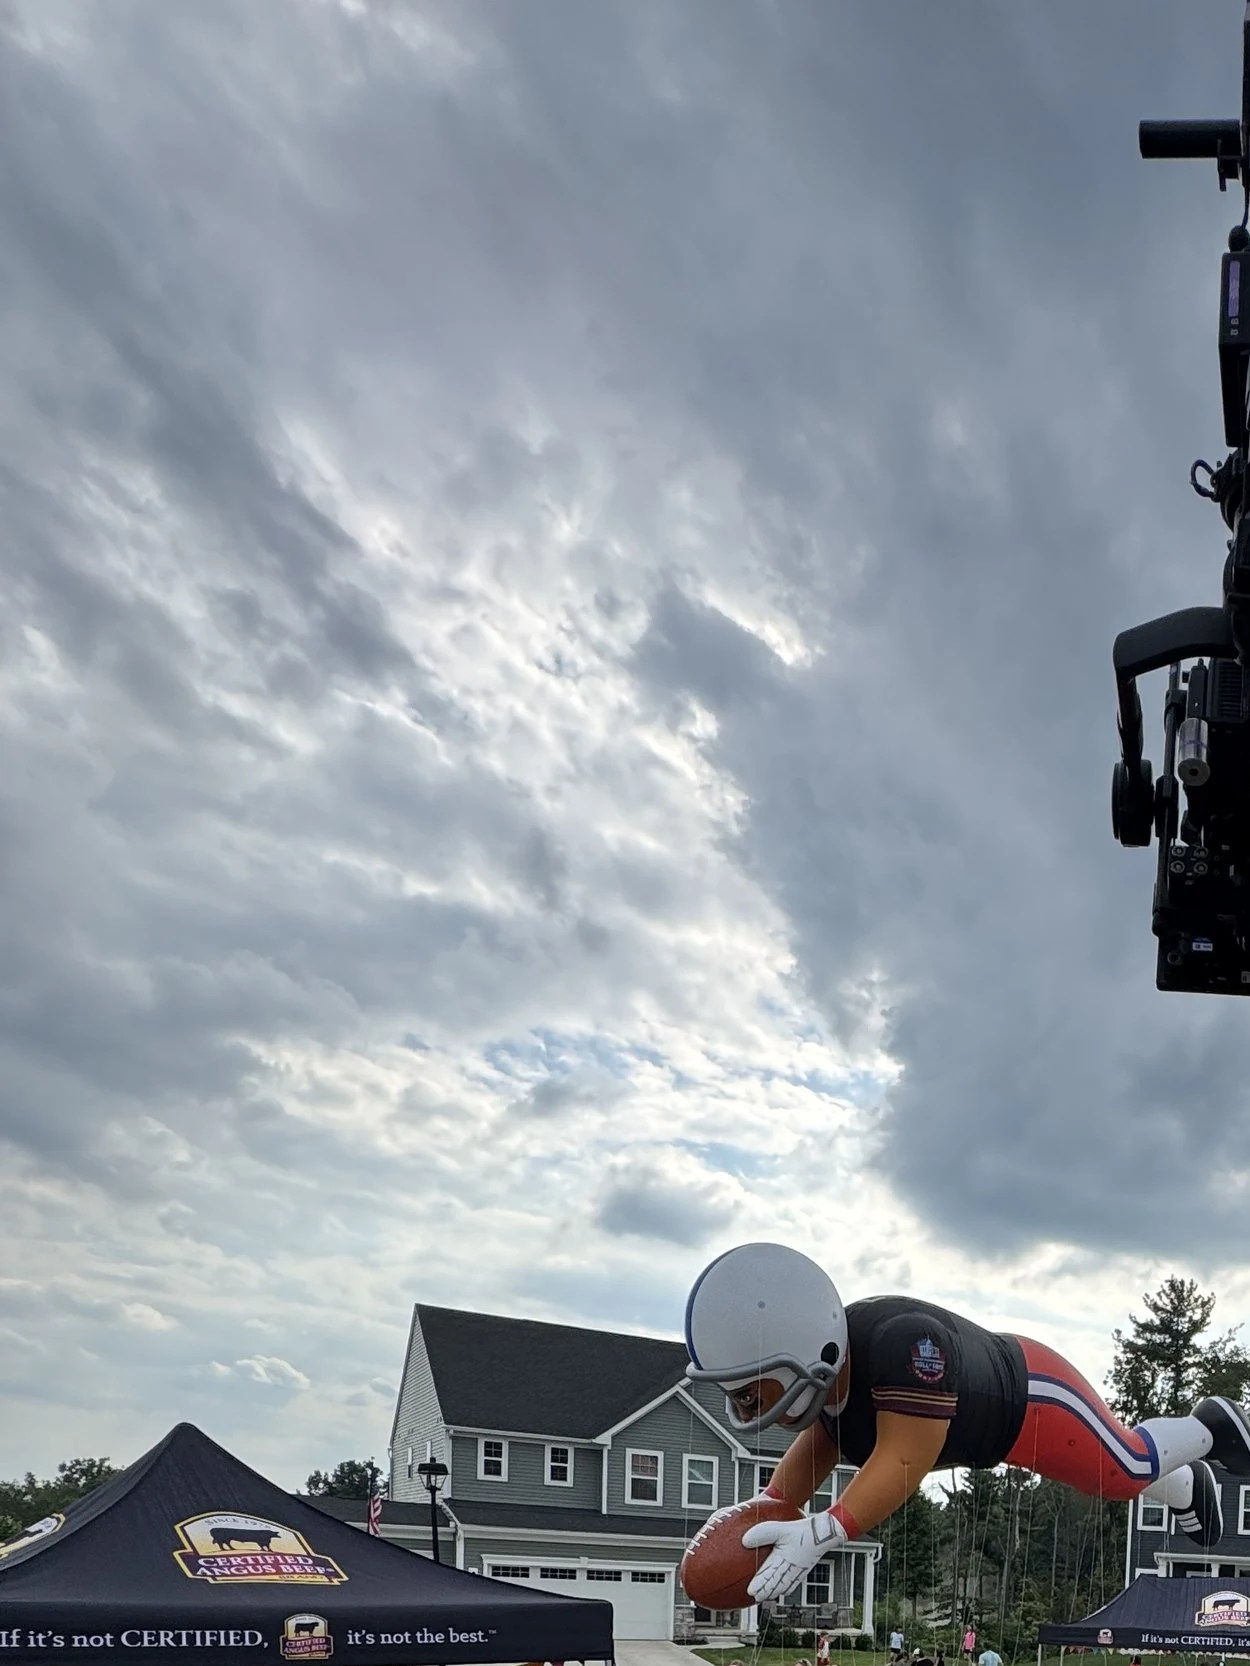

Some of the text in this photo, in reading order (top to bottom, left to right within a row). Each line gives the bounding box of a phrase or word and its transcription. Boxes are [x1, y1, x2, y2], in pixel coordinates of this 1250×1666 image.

[197, 1555, 314, 1568] CERTIFIED
[196, 1565, 276, 1576] ANGUS
[0, 1629, 22, 1648] If
[72, 1633, 115, 1648] not
[120, 1629, 269, 1649] CERTIFIED,
[379, 1631, 412, 1645] not
[414, 1629, 445, 1645] the
[1141, 1633, 1149, 1643] If
[1164, 1636, 1179, 1644] not
[1181, 1635, 1235, 1647] CERTIFIED,
